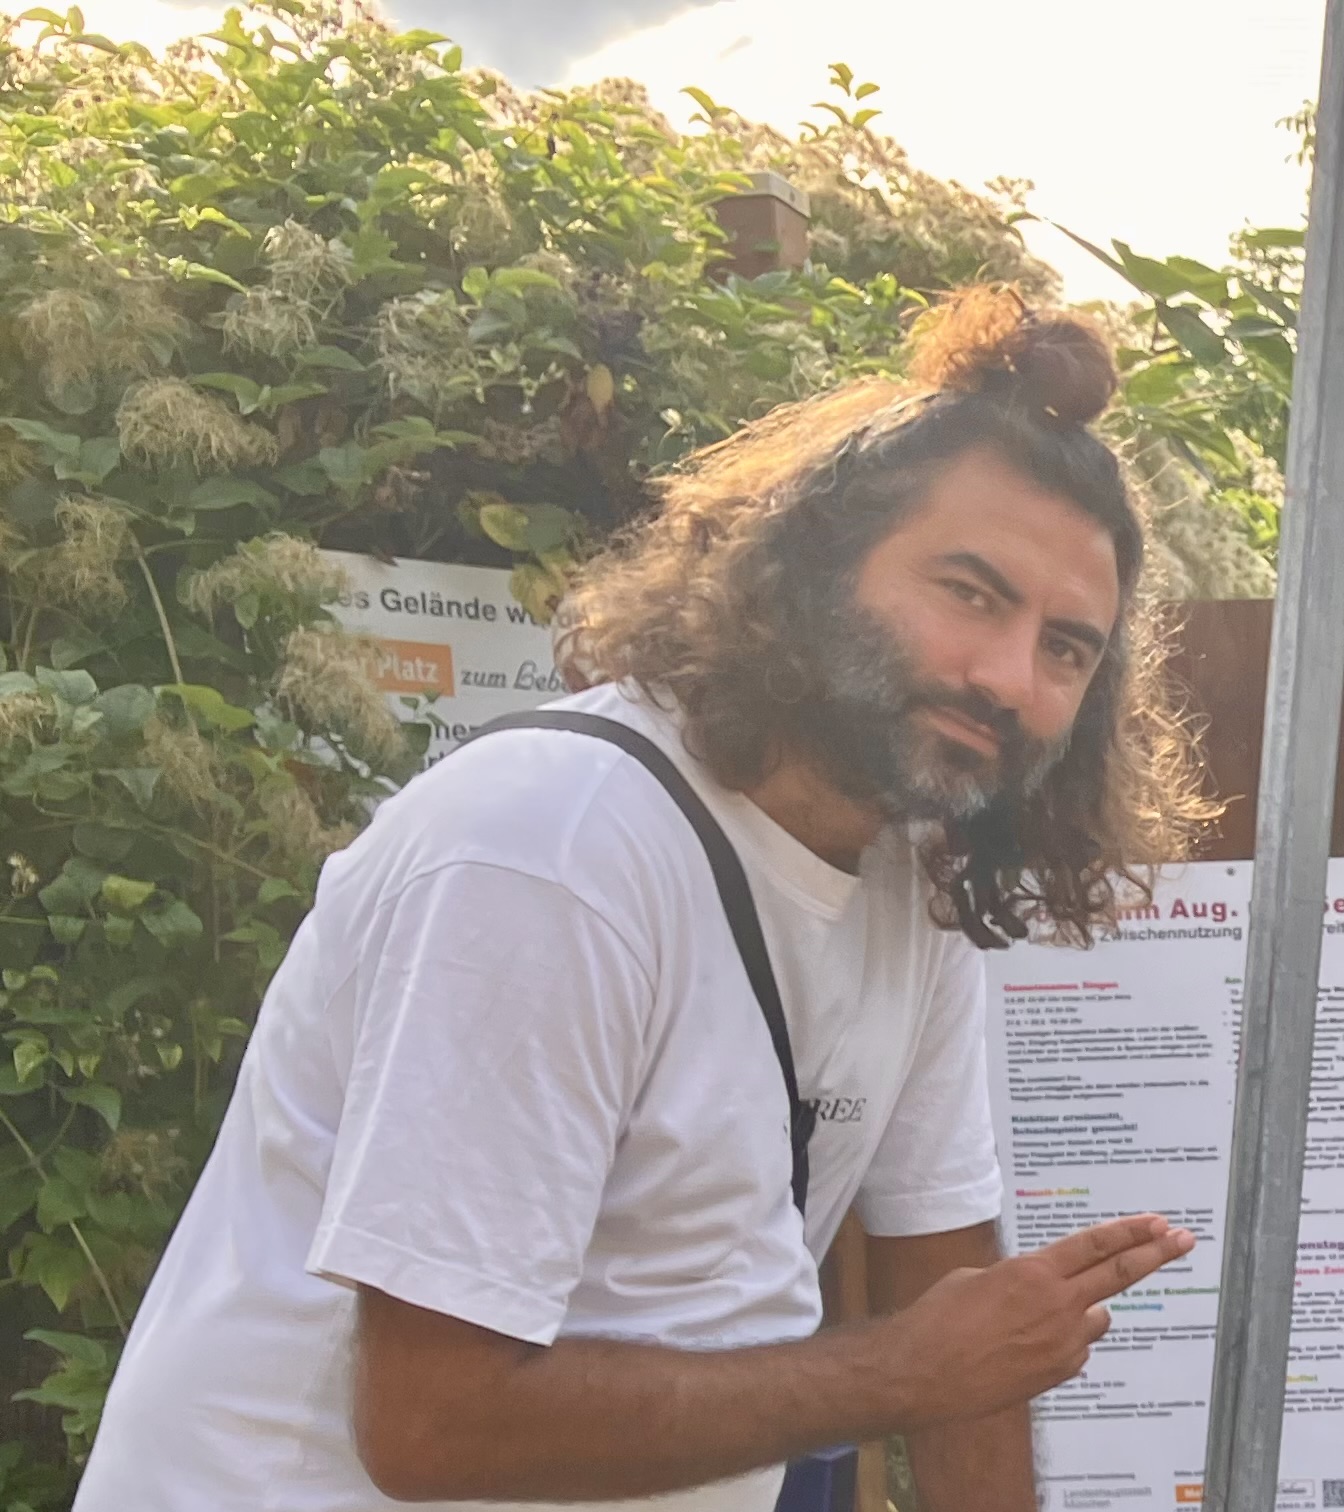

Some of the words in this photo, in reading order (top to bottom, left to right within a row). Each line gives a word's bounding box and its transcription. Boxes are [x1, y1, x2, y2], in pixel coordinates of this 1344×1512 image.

[380, 588, 497, 622] Gelände
[461, 670, 507, 688] zum
[1170, 897, 1238, 923] Aug.
[1099, 925, 1243, 943] Zwischennutzung
